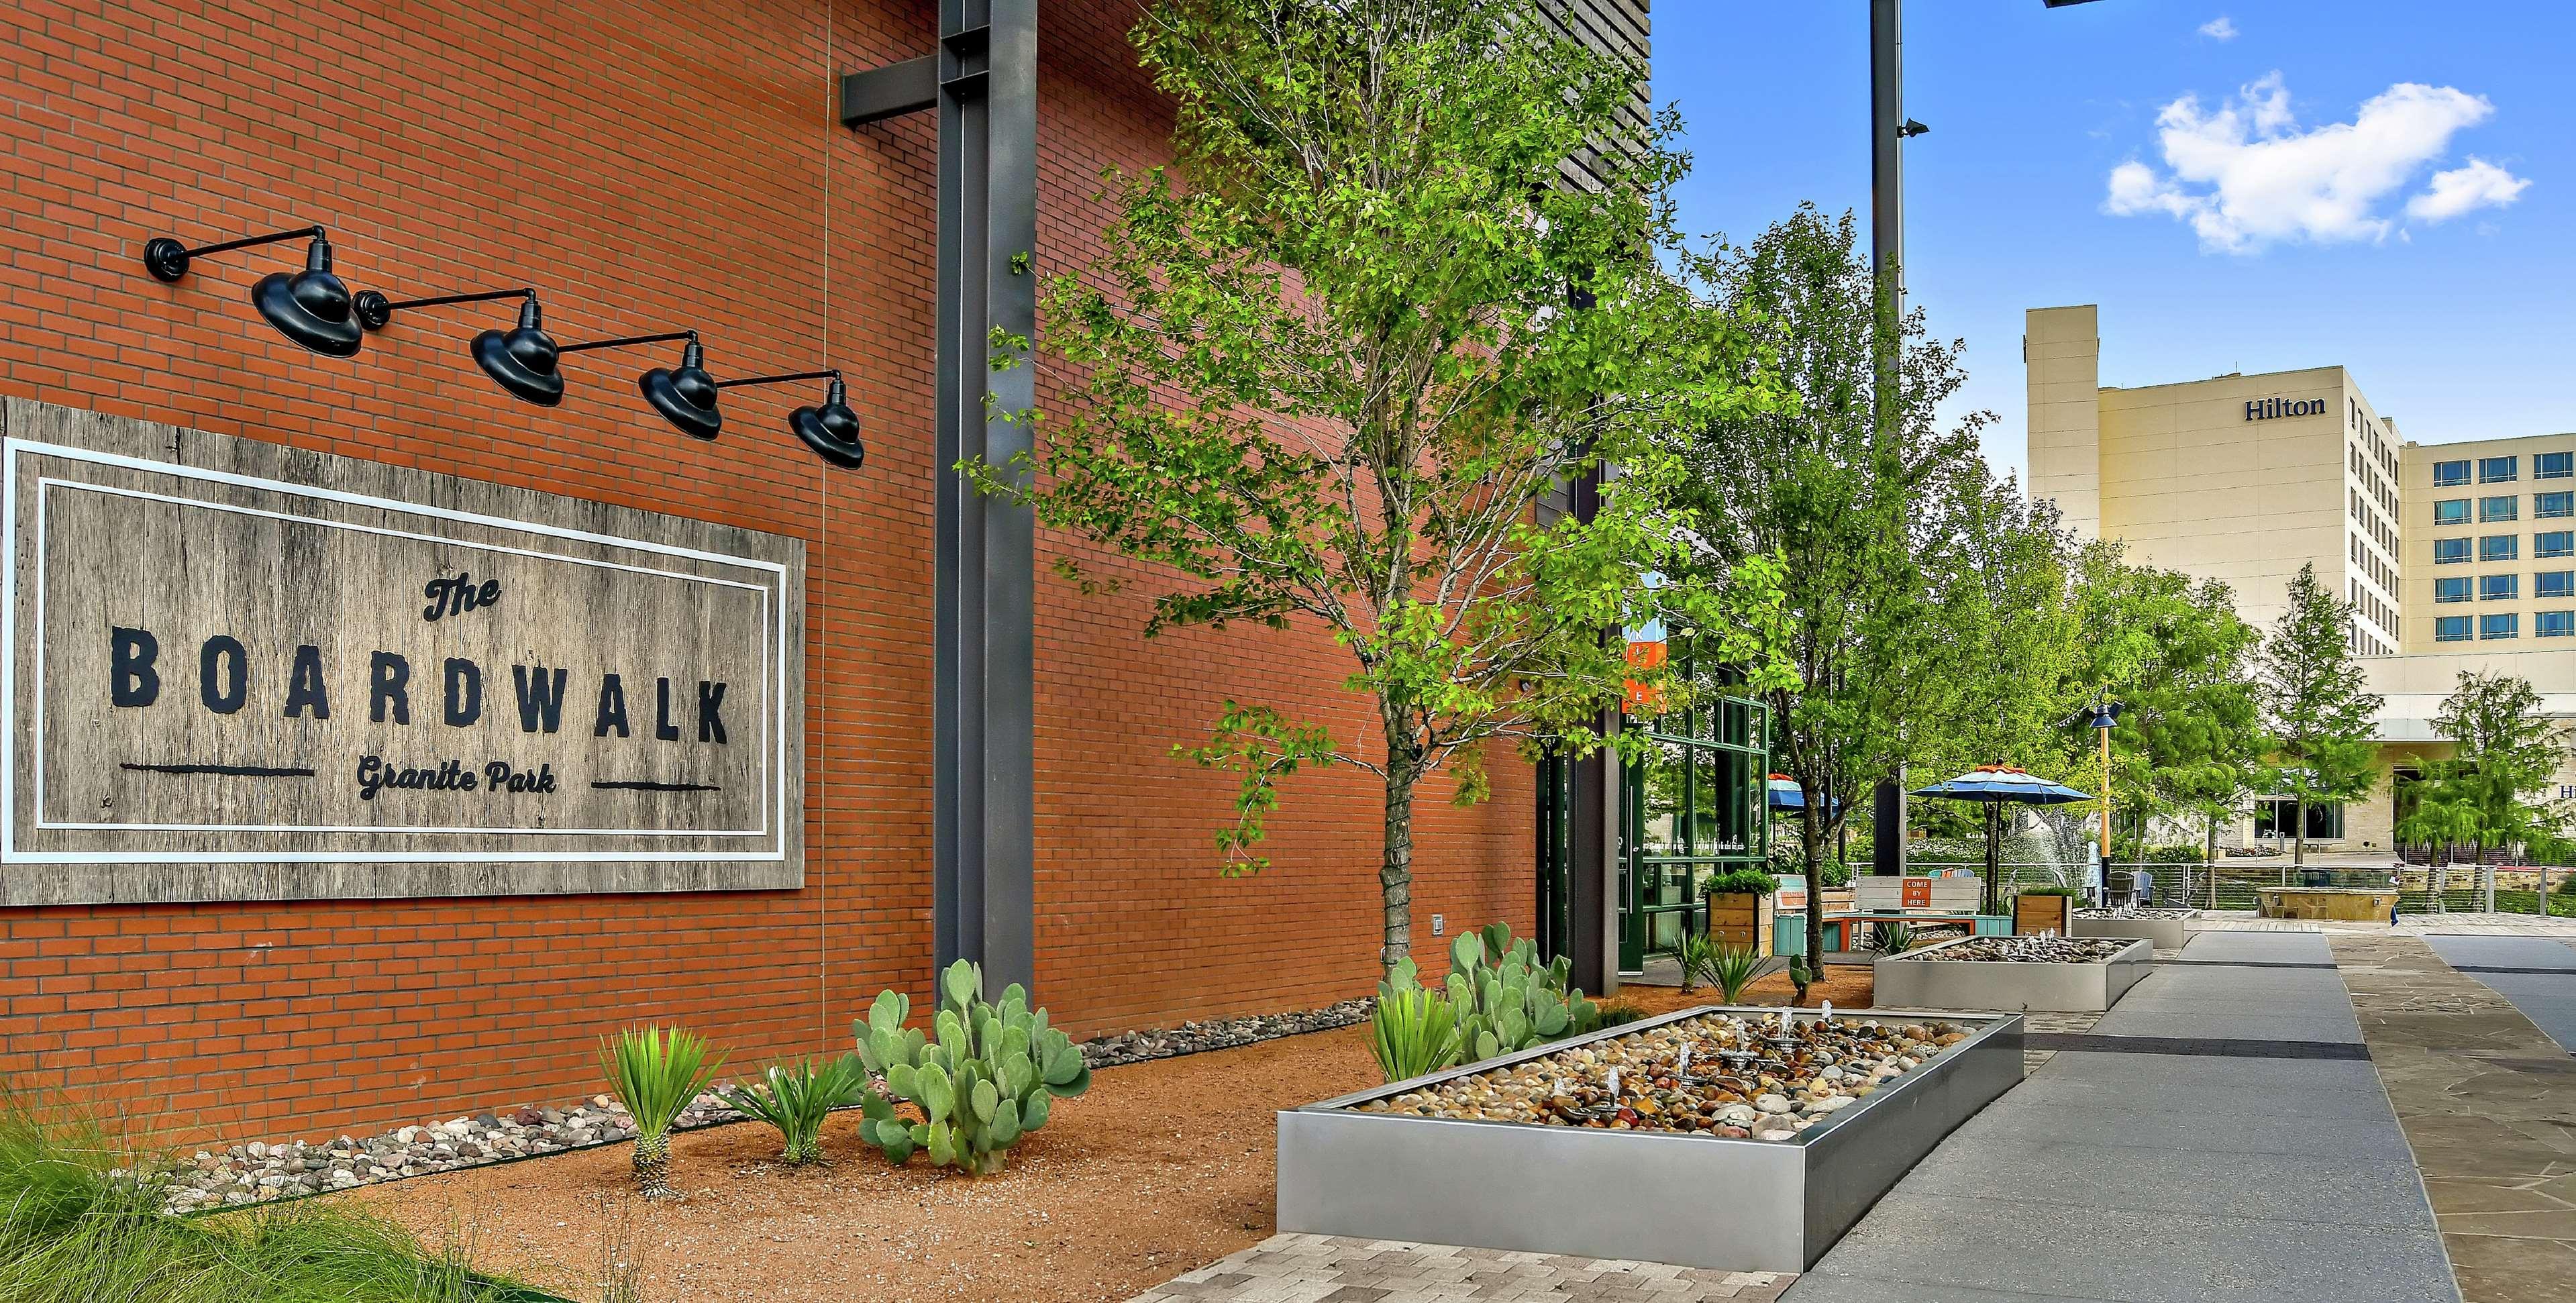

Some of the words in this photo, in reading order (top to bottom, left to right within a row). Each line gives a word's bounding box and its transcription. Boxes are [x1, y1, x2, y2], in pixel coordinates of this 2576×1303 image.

[2245, 397, 2326, 421] Hilton
[423, 572, 502, 622] The
[111, 625, 728, 745] BOARDWALK
[356, 755, 478, 800] Granite
[484, 760, 557, 794] Park
